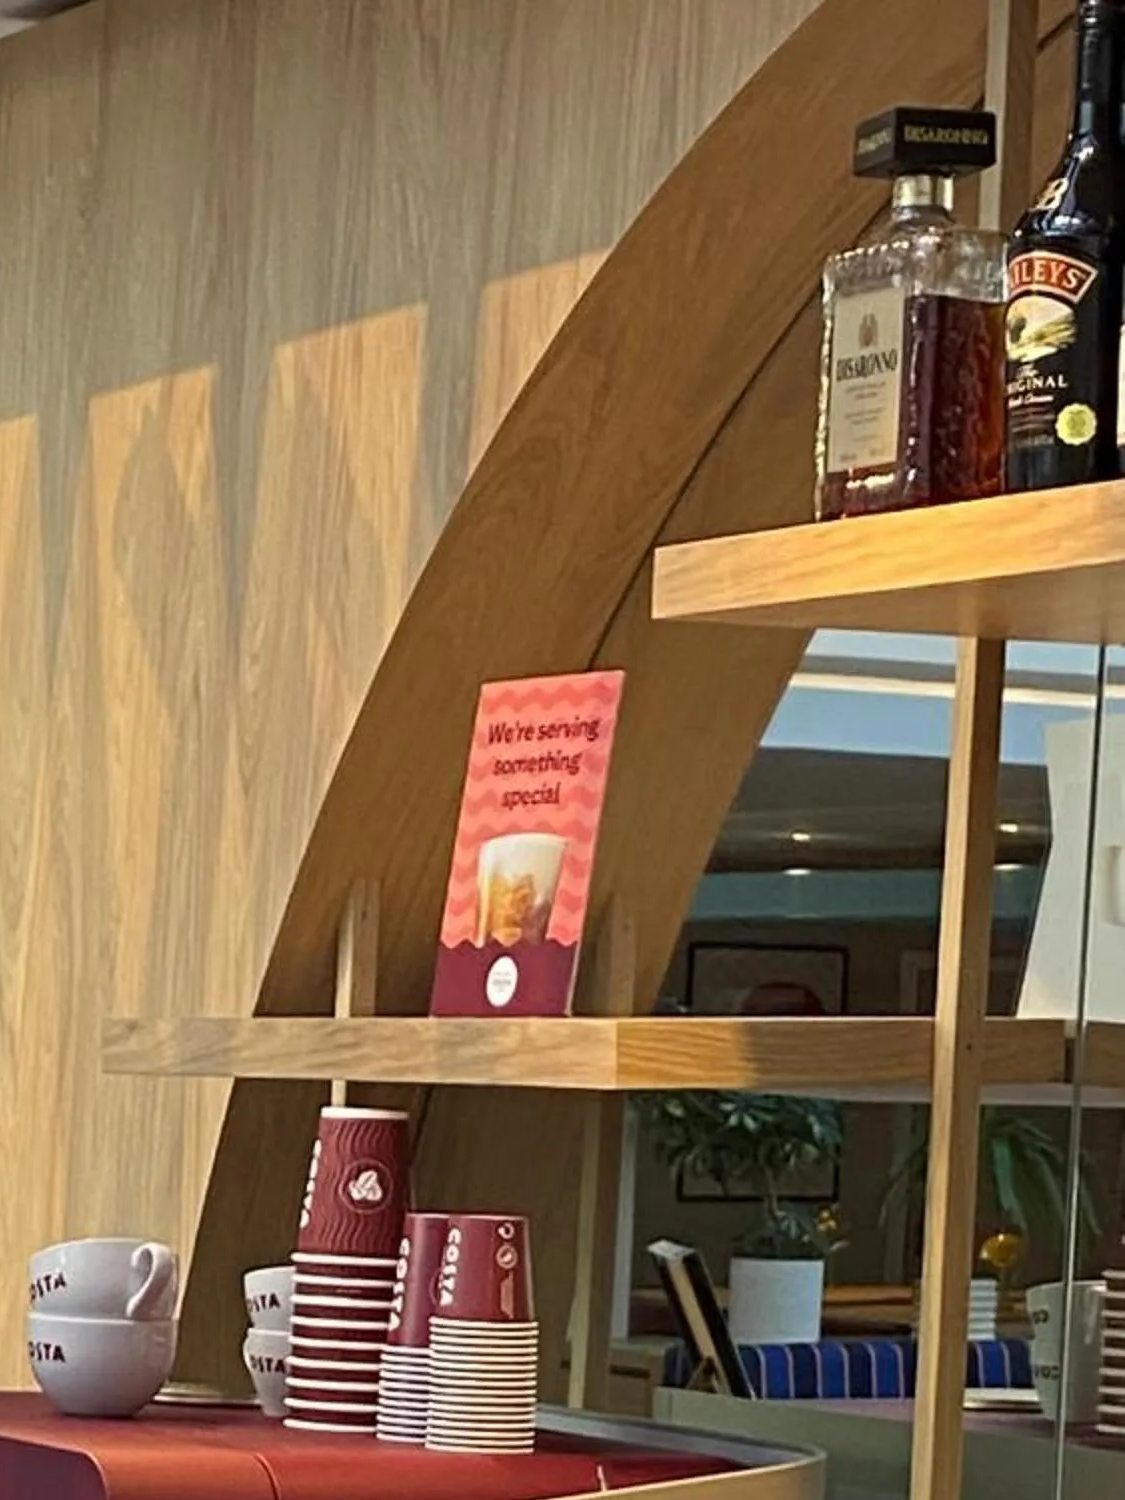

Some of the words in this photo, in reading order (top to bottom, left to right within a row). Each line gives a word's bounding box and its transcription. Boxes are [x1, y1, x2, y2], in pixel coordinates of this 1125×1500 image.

[1011, 259, 1081, 290] ILEYS
[488, 720, 536, 744] We're
[537, 716, 602, 742] serving
[493, 750, 583, 776] something
[501, 782, 562, 811] special
[440, 1228, 462, 1306] COSTA
[29, 1272, 67, 1304] OSTA
[27, 1340, 66, 1362] OSTA
[250, 1356, 286, 1374] OSTA
